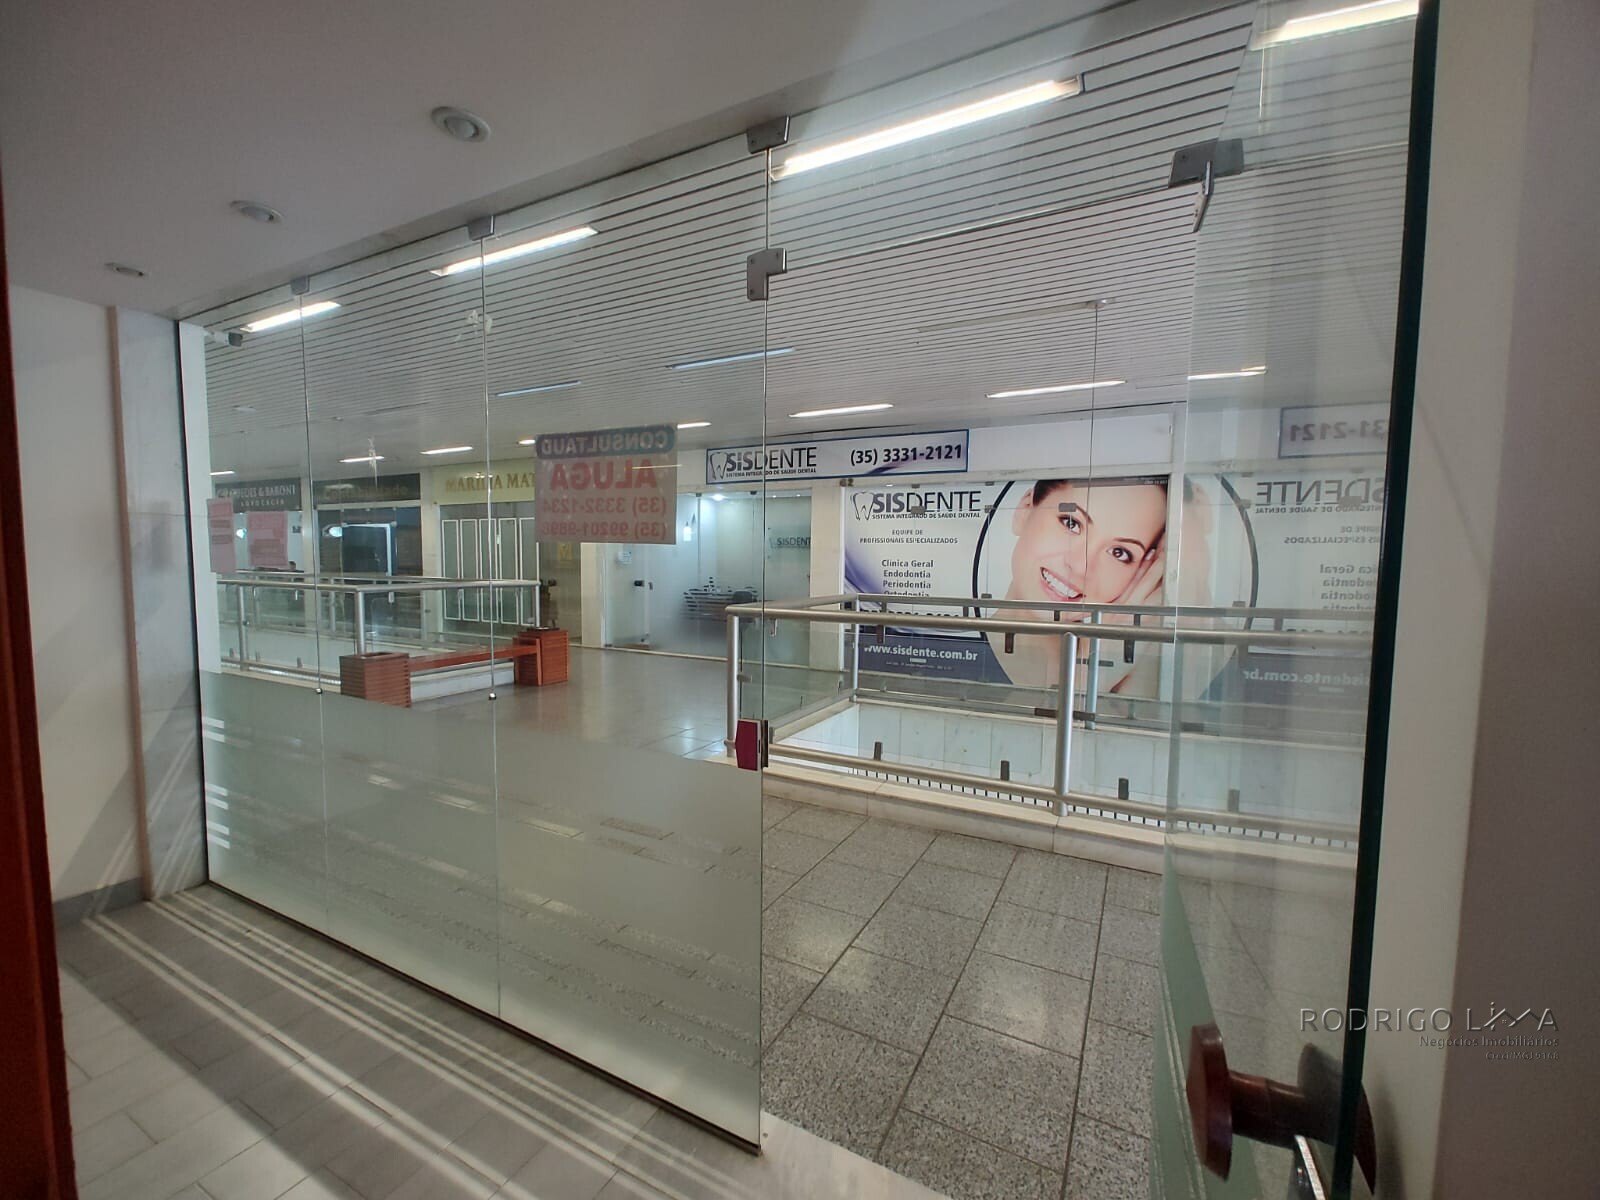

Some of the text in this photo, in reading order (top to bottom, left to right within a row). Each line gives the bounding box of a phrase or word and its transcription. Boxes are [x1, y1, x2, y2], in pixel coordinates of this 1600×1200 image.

[726, 446, 817, 472] SISDENTE
[850, 444, 962, 466] (35) 3331-2121
[745, 469, 772, 477] INTEGRDO
[872, 490, 982, 513] SISDENTE
[911, 559, 934, 568] Geral
[883, 569, 931, 578] Endodontia
[882, 580, 932, 589] Periodontia
[864, 644, 978, 661] www.sisdente.com.br
